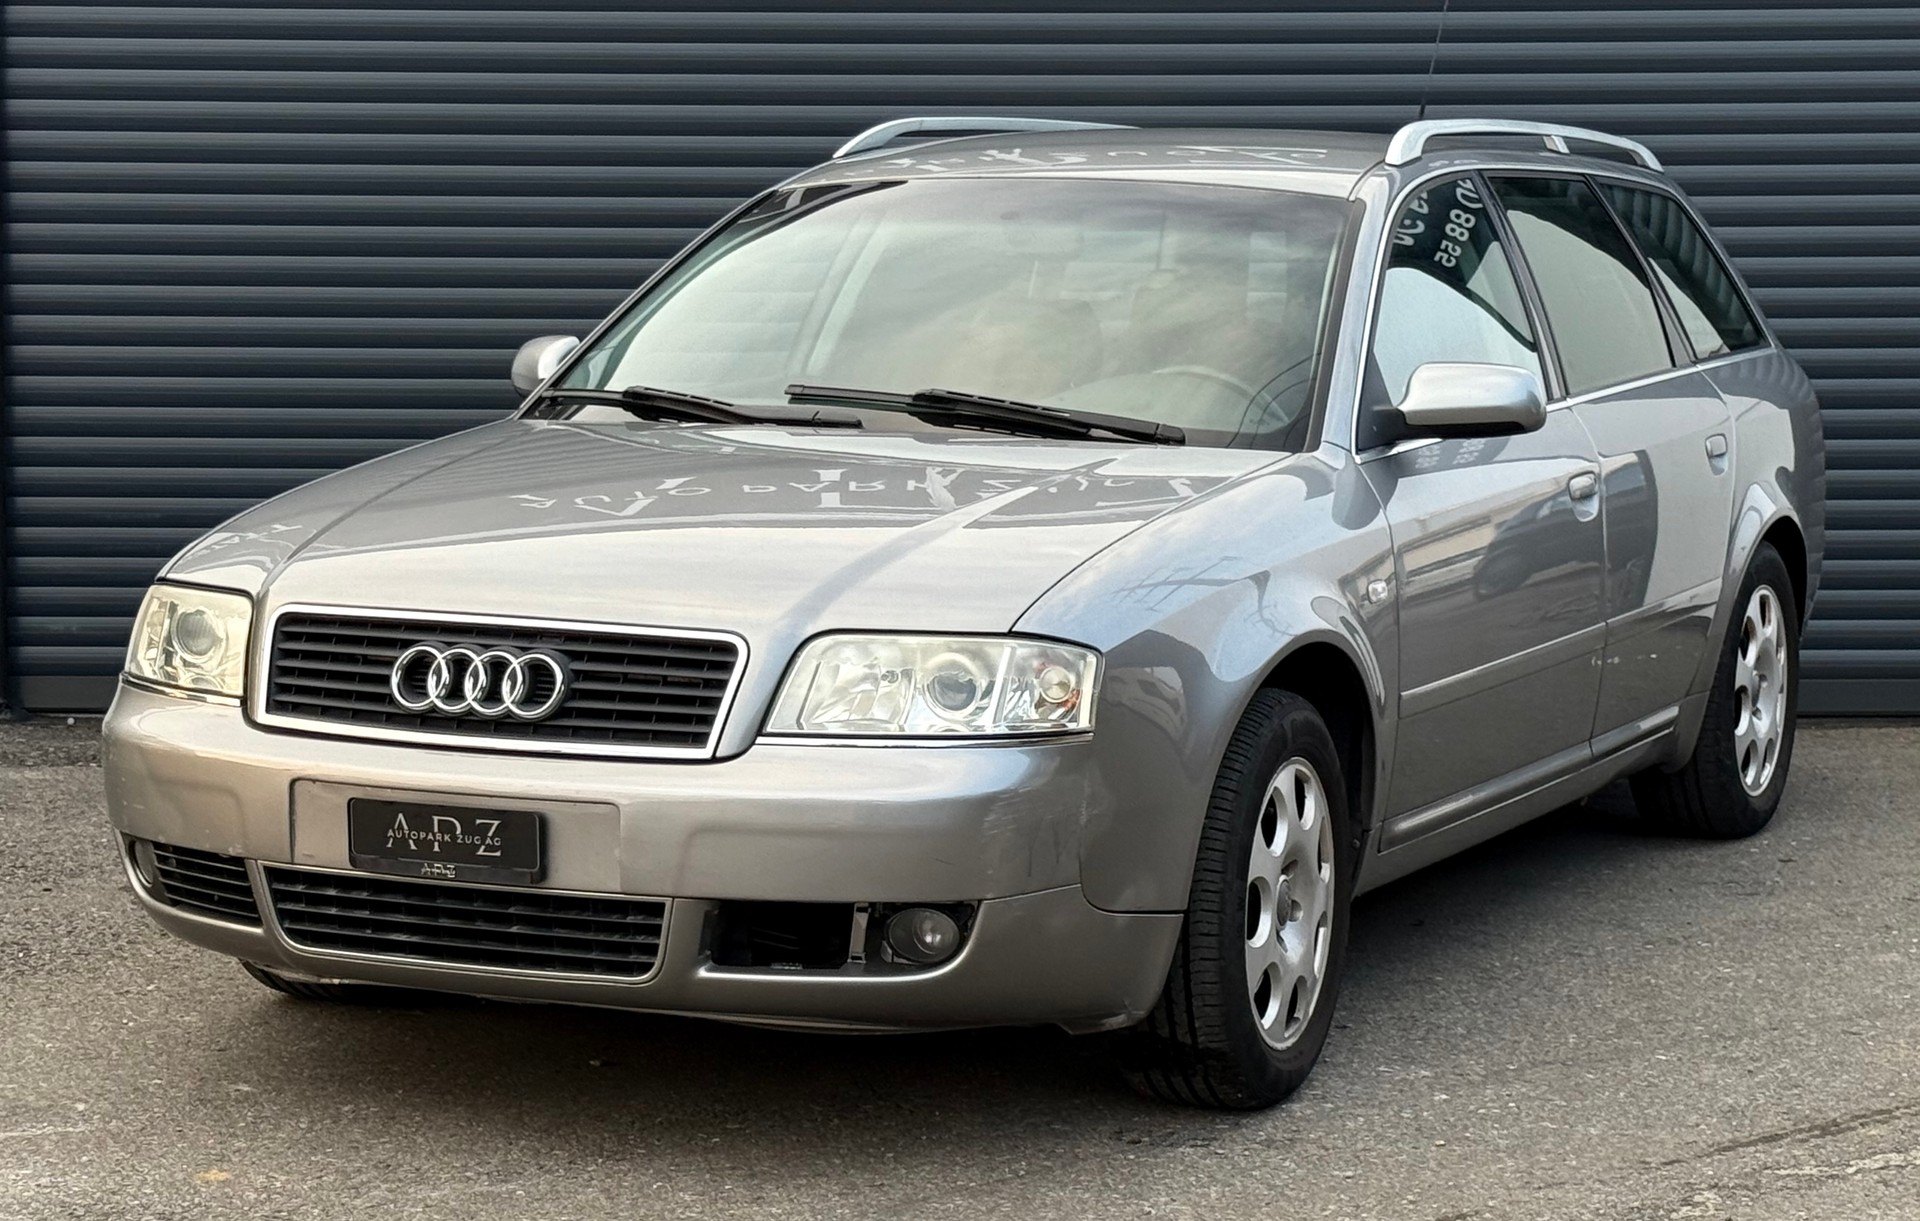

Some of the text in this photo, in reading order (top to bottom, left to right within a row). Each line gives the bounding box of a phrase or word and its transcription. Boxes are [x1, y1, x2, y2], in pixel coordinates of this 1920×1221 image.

[387, 829, 501, 846] AUTOPARK ZUG AG
